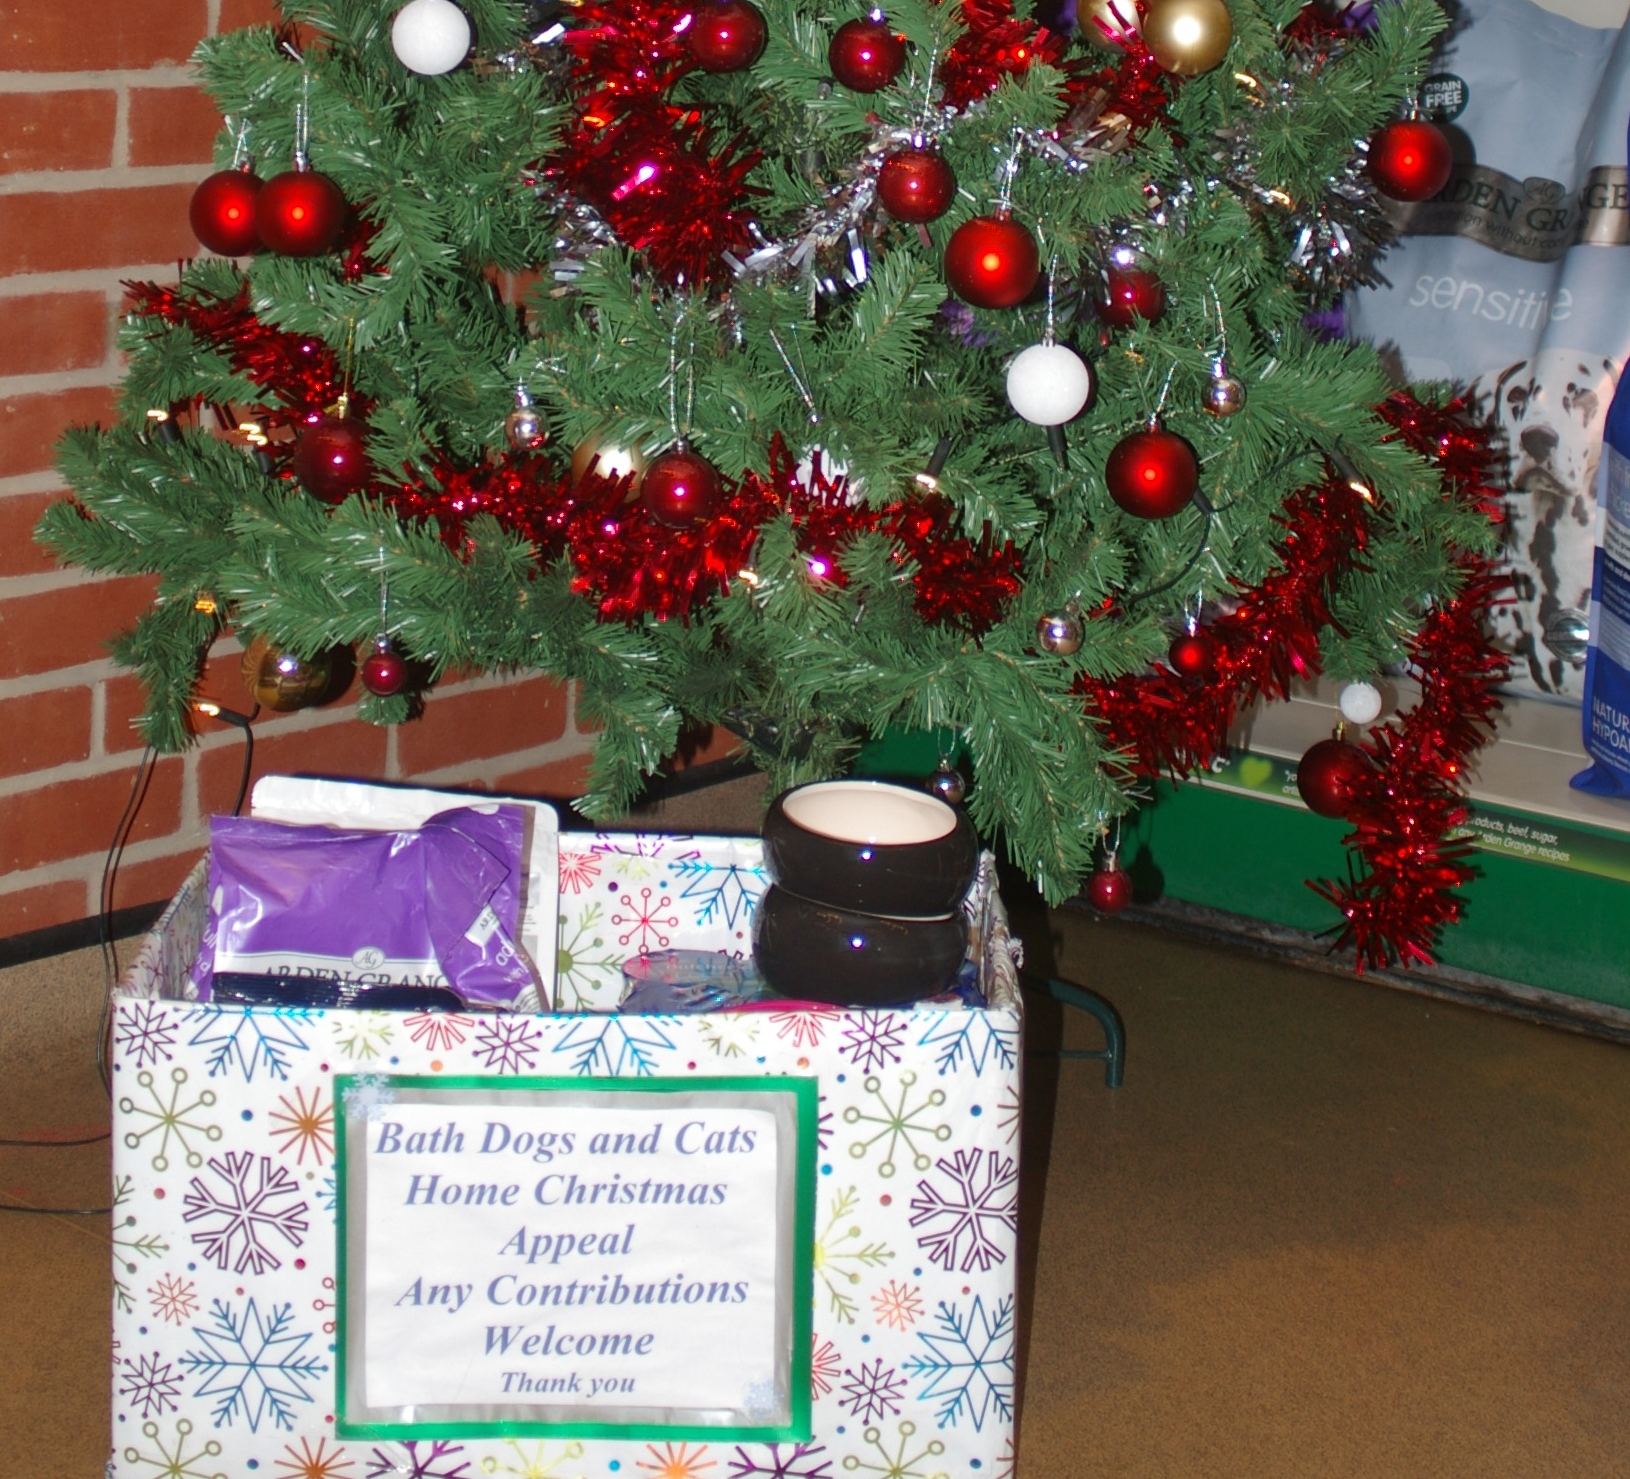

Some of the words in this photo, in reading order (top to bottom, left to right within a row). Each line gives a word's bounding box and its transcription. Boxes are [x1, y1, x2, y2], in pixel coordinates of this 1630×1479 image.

[1424, 80, 1462, 92] GRAIN
[1425, 91, 1463, 108] FREE
[1446, 178, 1521, 221] DEN
[1503, 837, 1537, 855] Grange
[1538, 846, 1571, 862] recipes
[1507, 822, 1530, 839] beef,
[1531, 829, 1558, 846] sugar,
[373, 1122, 465, 1155] Bath
[478, 1122, 576, 1164] Dogs
[588, 1123, 663, 1155] and
[674, 1120, 758, 1155] Cats
[403, 1173, 521, 1206] Home
[534, 1173, 728, 1206] Christmas
[498, 1223, 636, 1265] Appeal
[394, 1276, 473, 1314] Any
[486, 1273, 750, 1307] Contributions
[484, 1324, 655, 1356] Welcome
[500, 1371, 582, 1394] Thank
[586, 1376, 636, 1398] you
